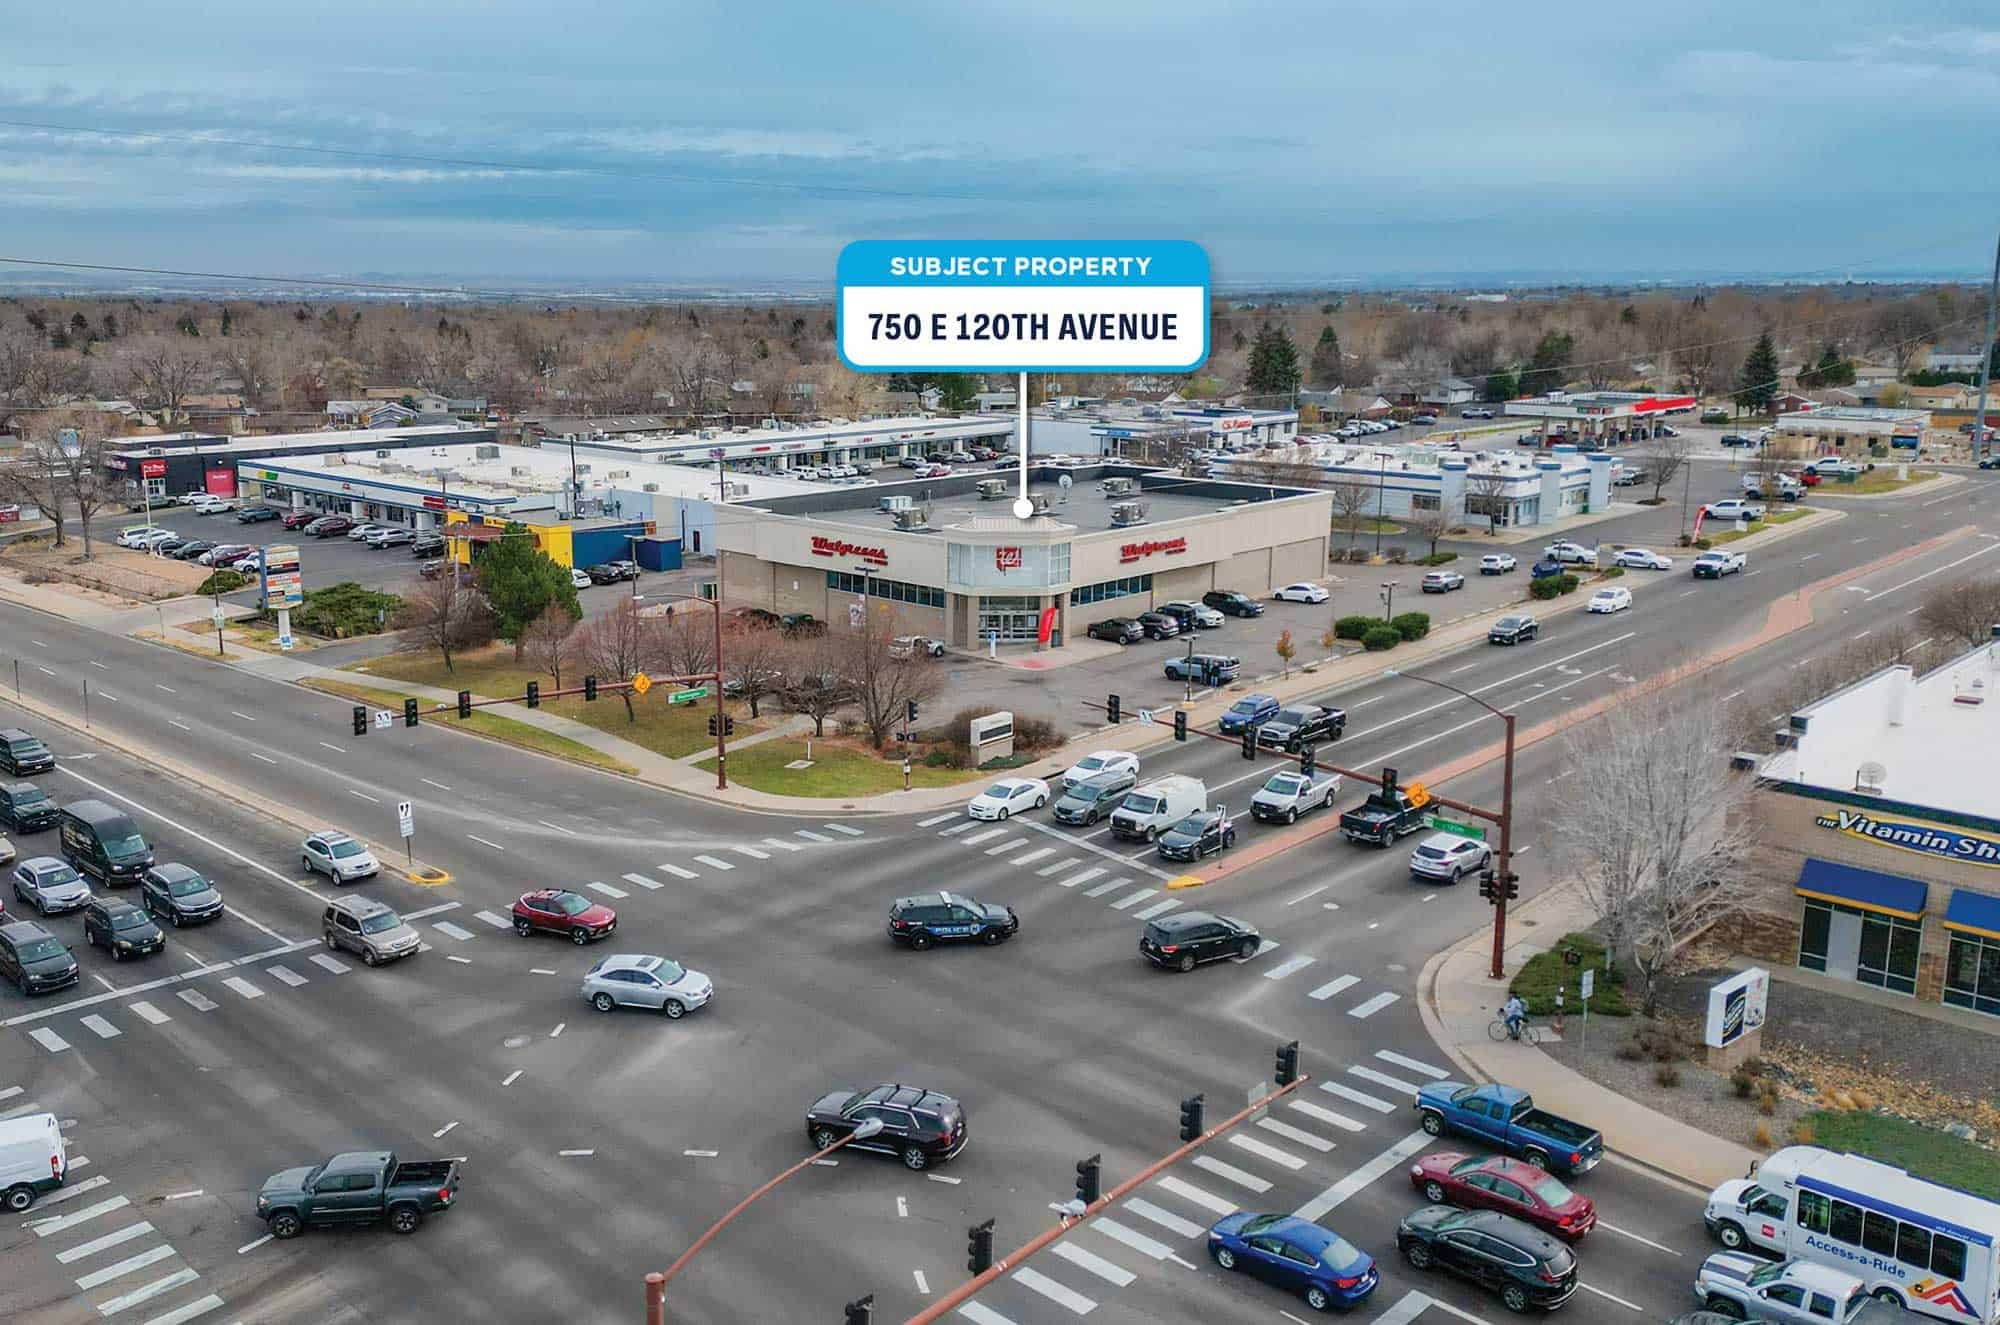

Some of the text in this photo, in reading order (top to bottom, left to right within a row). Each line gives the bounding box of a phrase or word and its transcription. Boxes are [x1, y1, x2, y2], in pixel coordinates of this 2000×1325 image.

[811, 536, 888, 559] Walgreens
[1838, 809, 1951, 852] Vitamin
[1953, 836, 2000, 862] Sh
[935, 926, 970, 935] POLICE
[1805, 1235, 1907, 1279] Access-a-Ride
